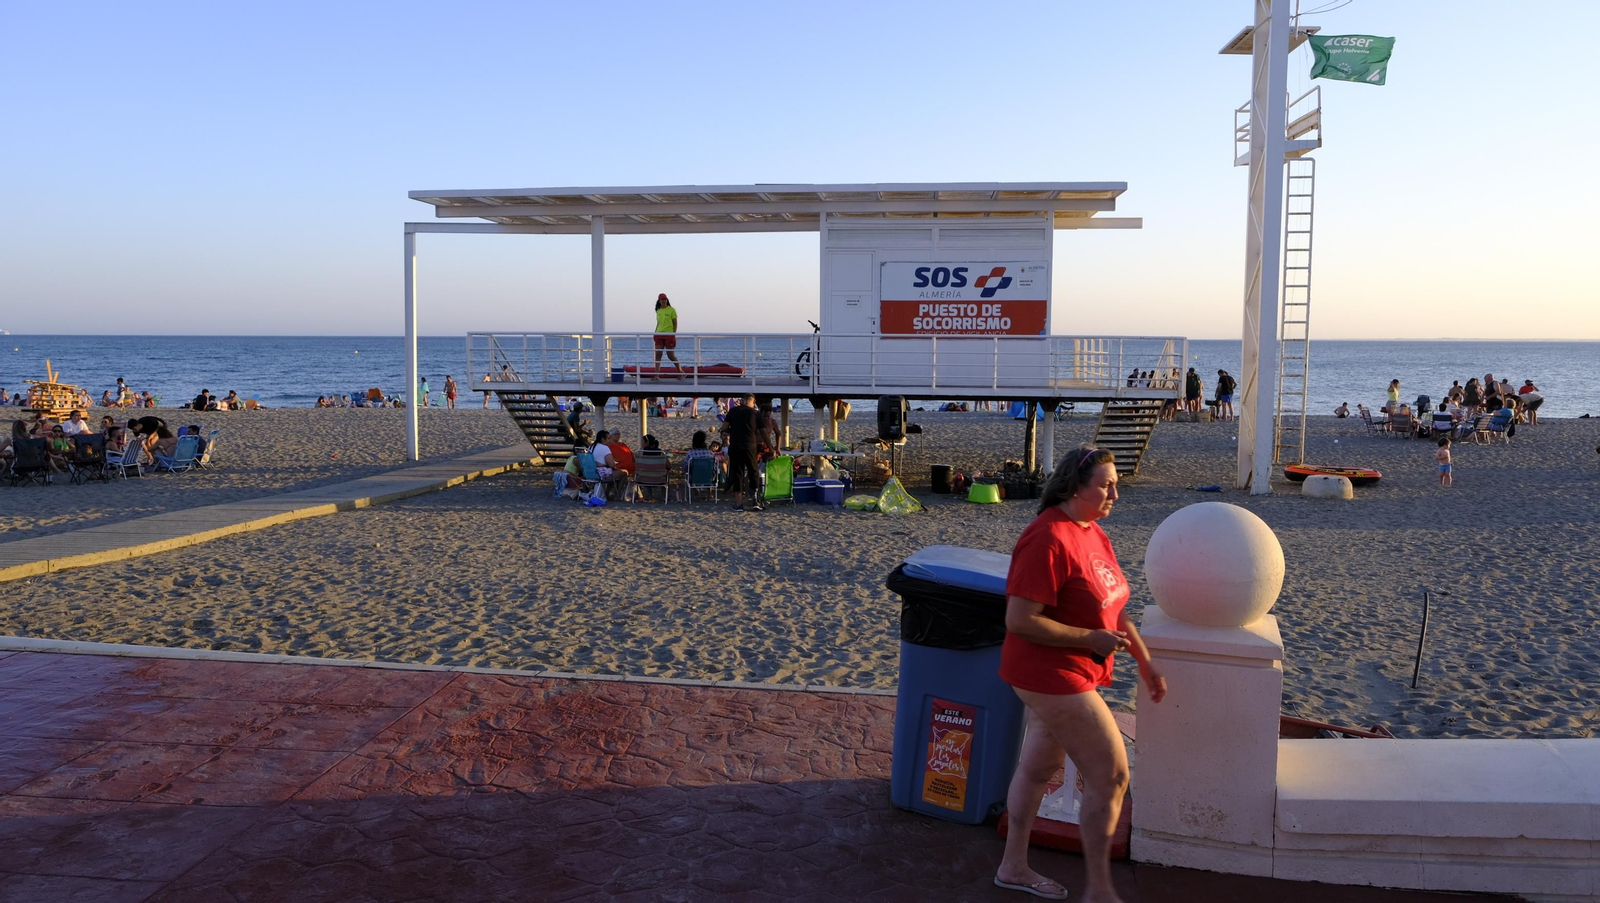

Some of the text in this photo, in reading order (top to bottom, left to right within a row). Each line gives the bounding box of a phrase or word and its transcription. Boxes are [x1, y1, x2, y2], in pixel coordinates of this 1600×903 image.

[1333, 37, 1374, 48] caser
[913, 266, 969, 288] SOS
[919, 289, 962, 299] ALMERÍA
[919, 304, 1002, 317] PUESTO DE
[912, 317, 1012, 330] SOCORRISMO
[934, 713, 973, 726] VERANO
[944, 709, 960, 717] ESTE
